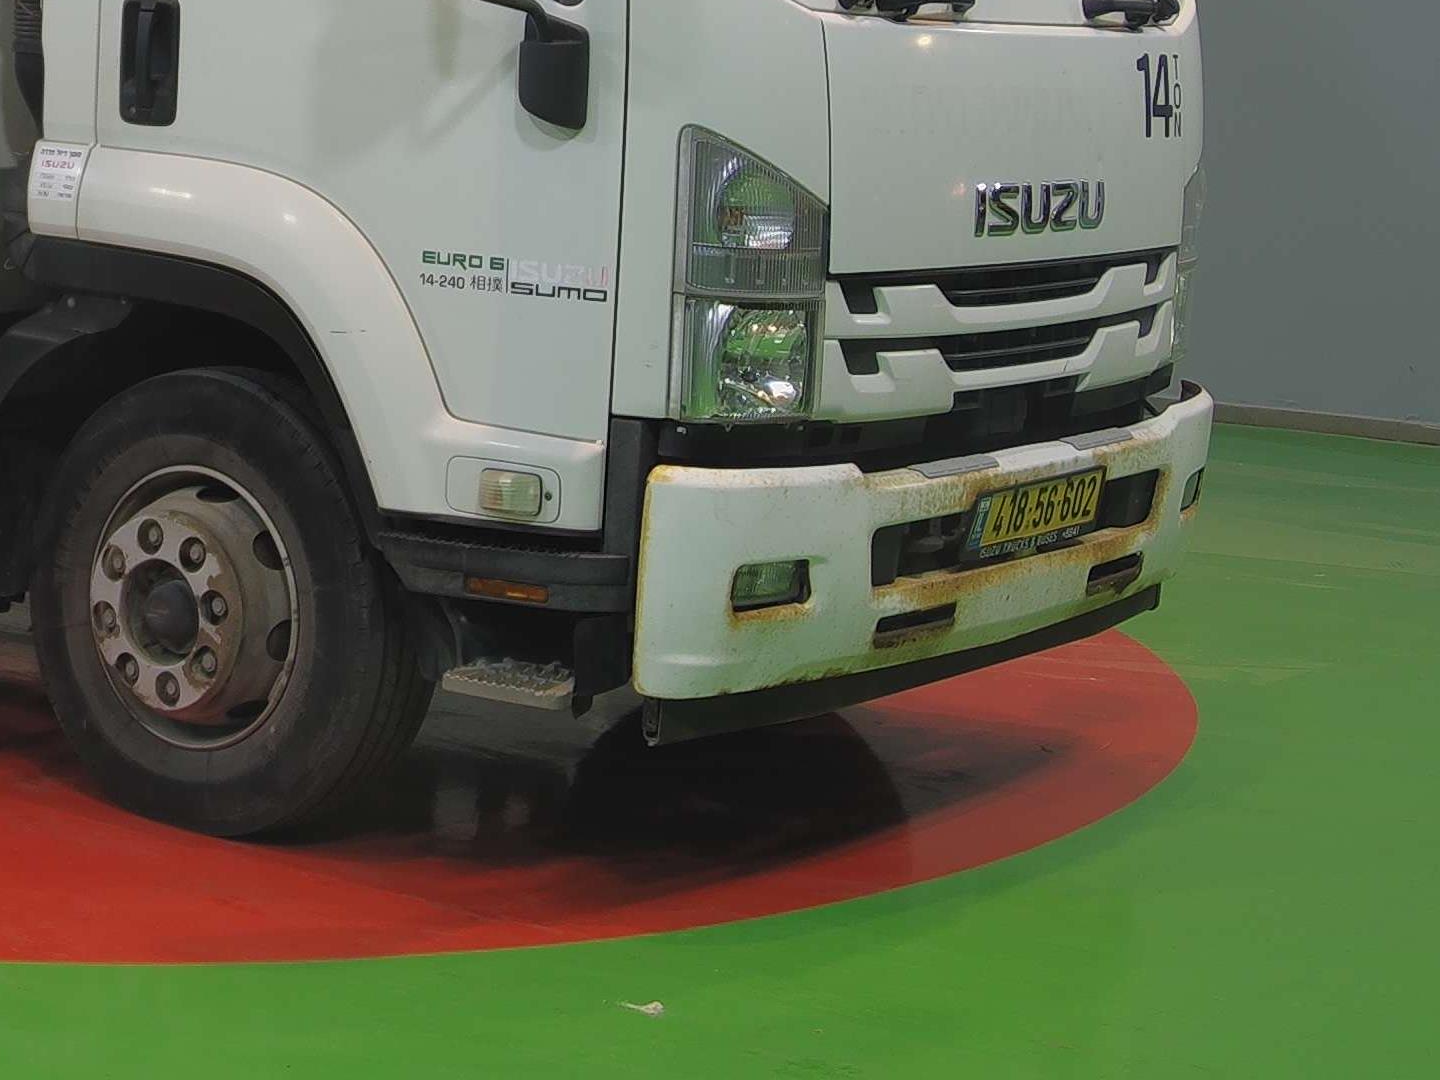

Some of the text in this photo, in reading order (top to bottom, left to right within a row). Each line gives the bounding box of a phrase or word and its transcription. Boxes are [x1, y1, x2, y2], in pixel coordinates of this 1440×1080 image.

[1136, 52, 1182, 139] 14 TON
[41, 160, 75, 170] ISUZU
[973, 178, 1106, 237] ISUZU
[421, 250, 506, 271] EURO 6
[419, 272, 466, 290] 14-240
[510, 259, 611, 287] ISUZU
[510, 281, 609, 303] SUMO
